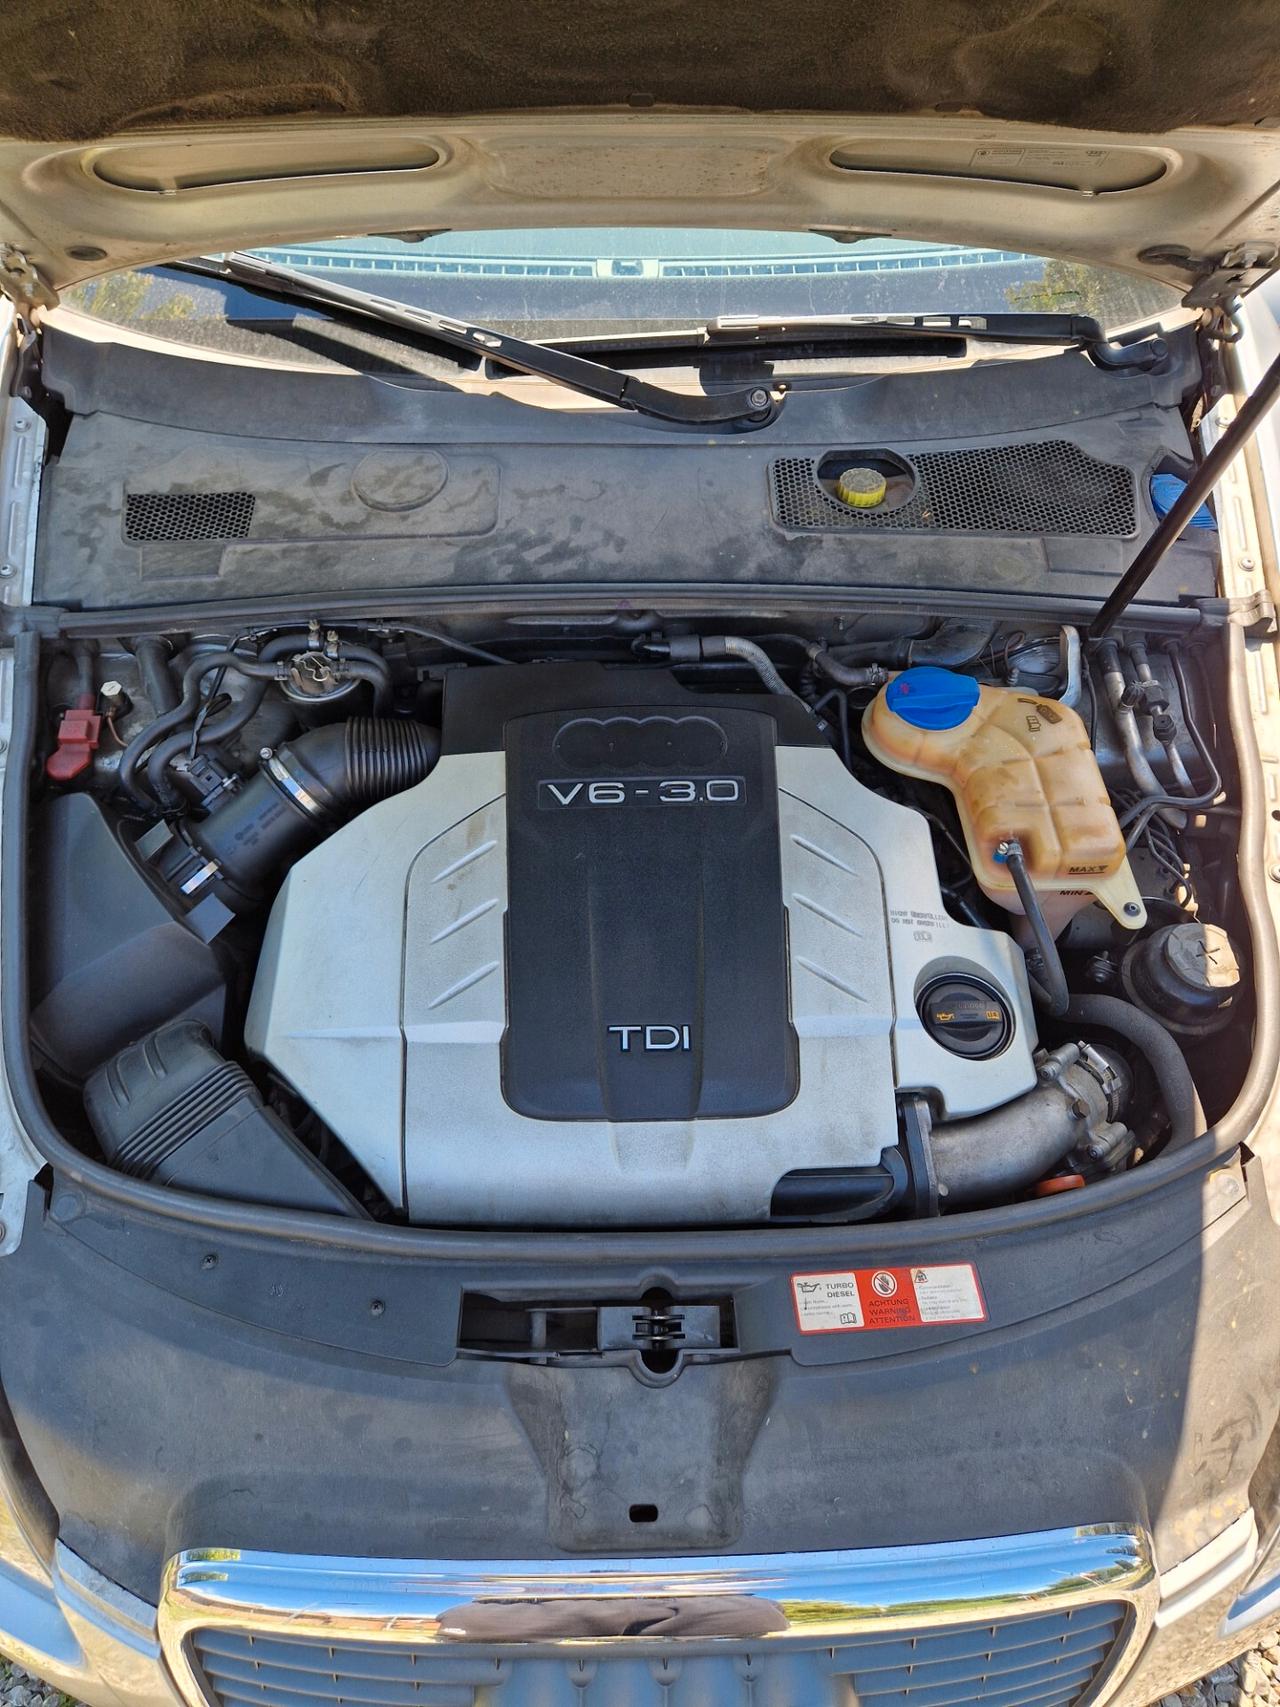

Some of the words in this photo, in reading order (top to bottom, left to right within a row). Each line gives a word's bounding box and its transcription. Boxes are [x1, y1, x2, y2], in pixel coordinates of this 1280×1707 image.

[608, 1025, 690, 1050] TDI
[826, 1282, 854, 1290] TURBO
[827, 1290, 855, 1298] DIESEL
[869, 1298, 909, 1307] ACHTUNG
[869, 1306, 911, 1316] WARNING
[869, 1315, 916, 1324] ATTENTION
